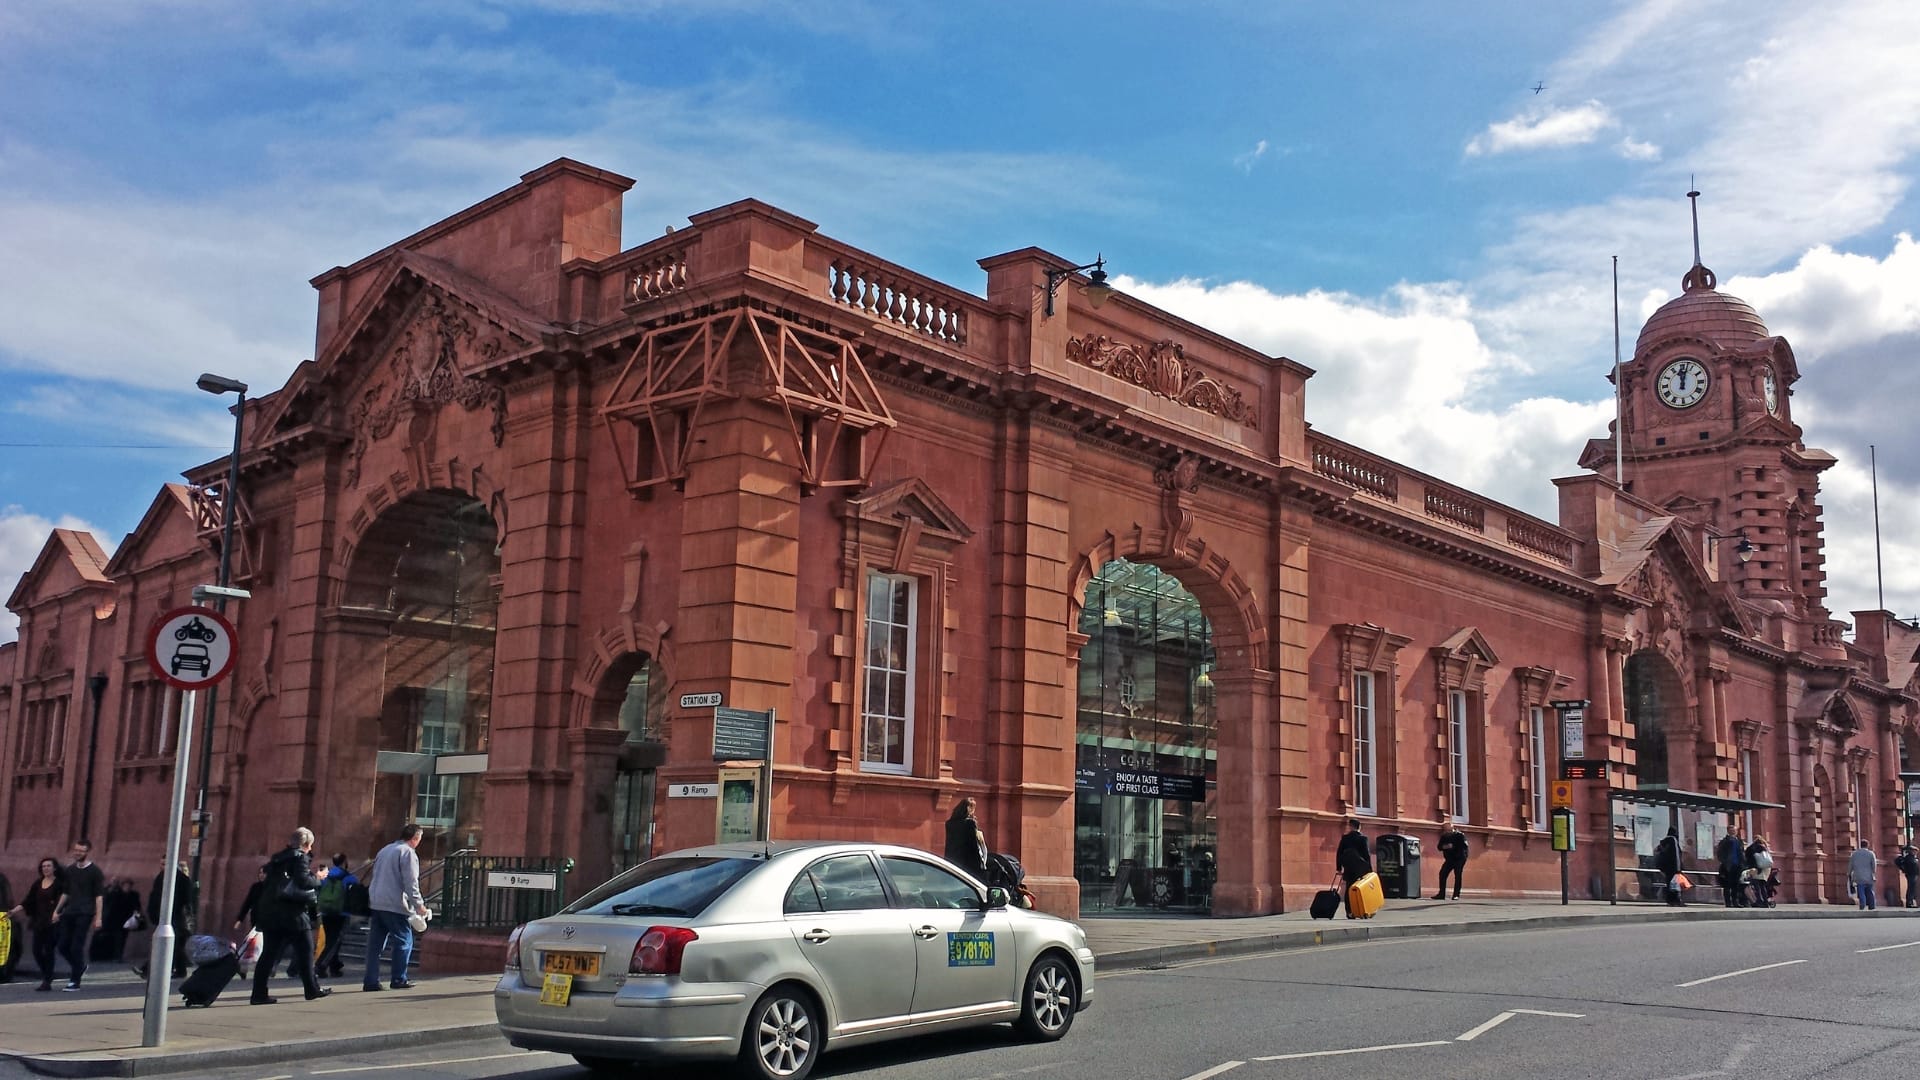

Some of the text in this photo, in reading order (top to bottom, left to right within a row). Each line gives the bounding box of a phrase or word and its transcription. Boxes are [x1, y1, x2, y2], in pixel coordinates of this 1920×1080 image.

[682, 695, 709, 706] STATION
[1116, 772, 1135, 783] ENJOY
[1136, 774, 1141, 783] A
[1142, 775, 1158, 785] TASTE
[691, 785, 708, 796] Ramp
[1116, 783, 1159, 795] OF FIRST CLASS
